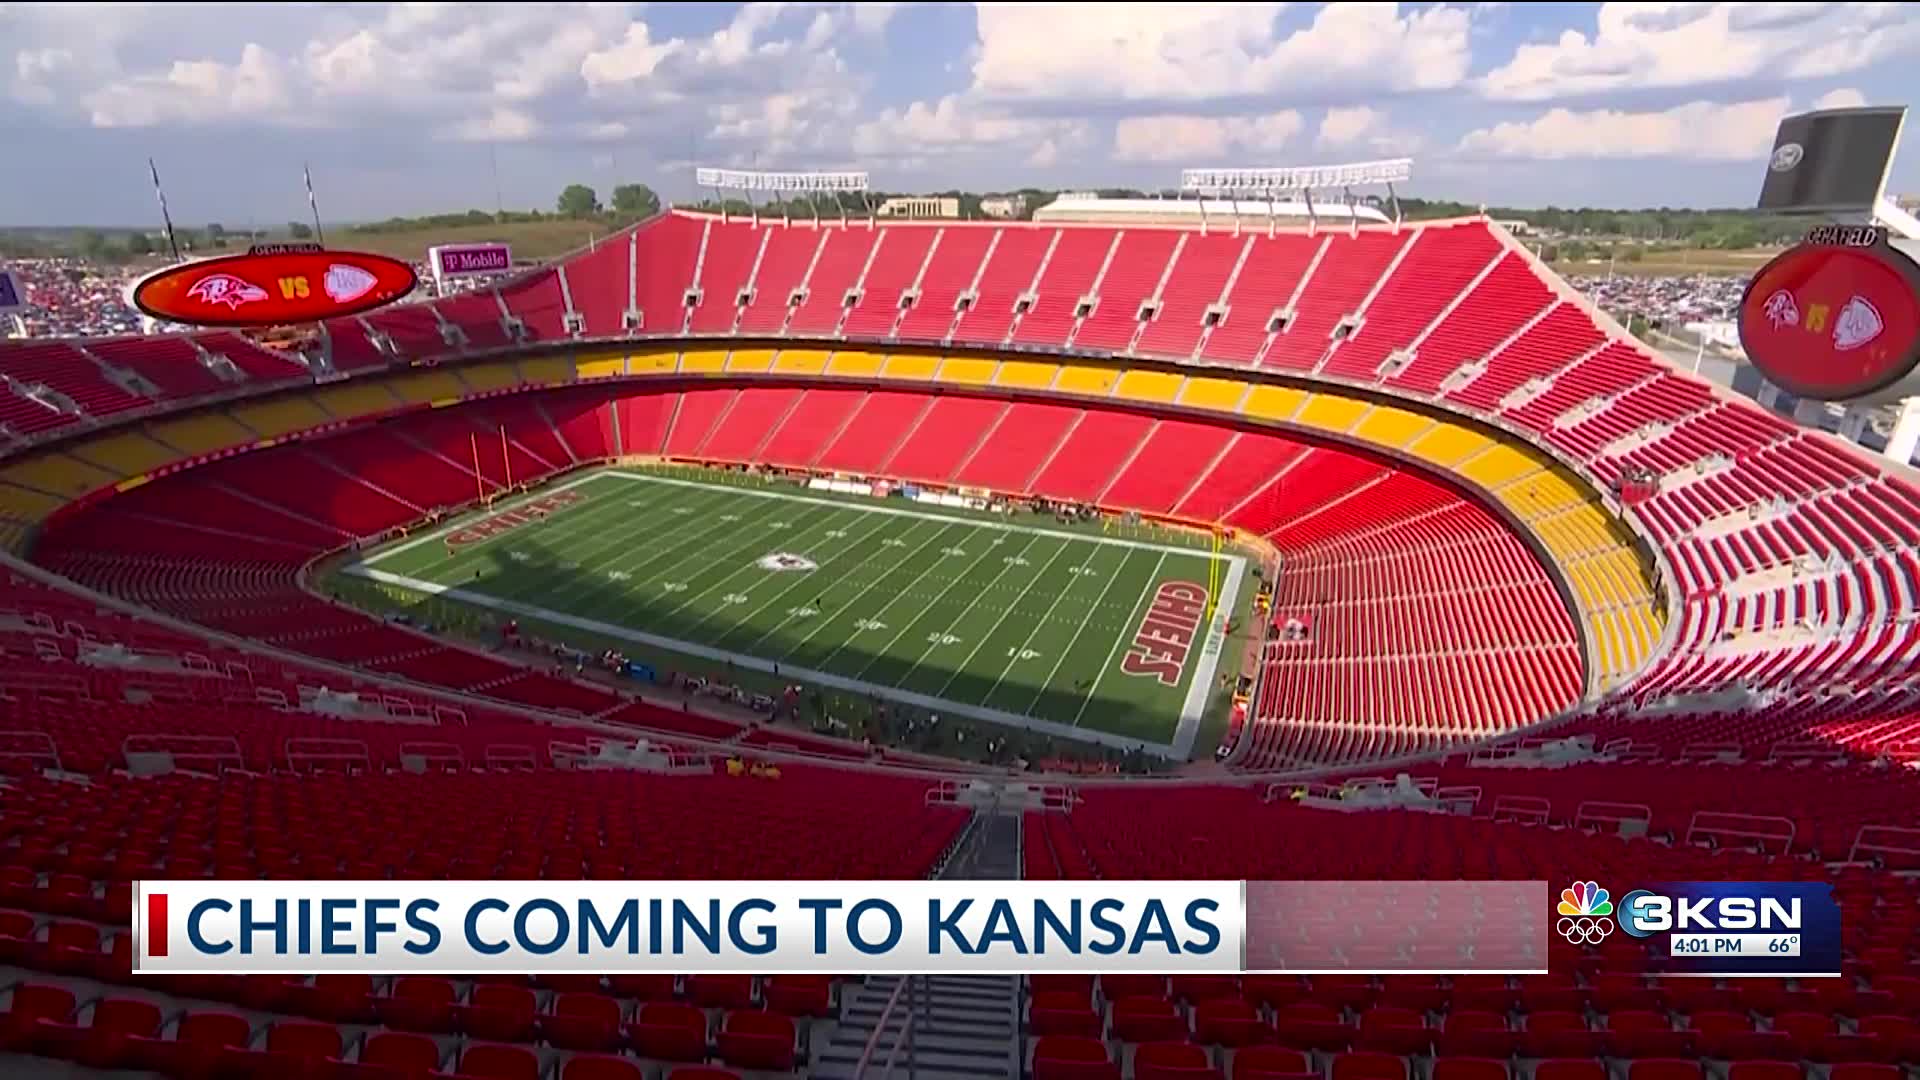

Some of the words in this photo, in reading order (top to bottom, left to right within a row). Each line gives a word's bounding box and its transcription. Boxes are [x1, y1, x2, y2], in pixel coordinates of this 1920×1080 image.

[460, 252, 505, 269] Mobile
[277, 276, 311, 300] VS
[1120, 581, 1209, 687] CHIEFS
[1007, 647, 1033, 660] 10
